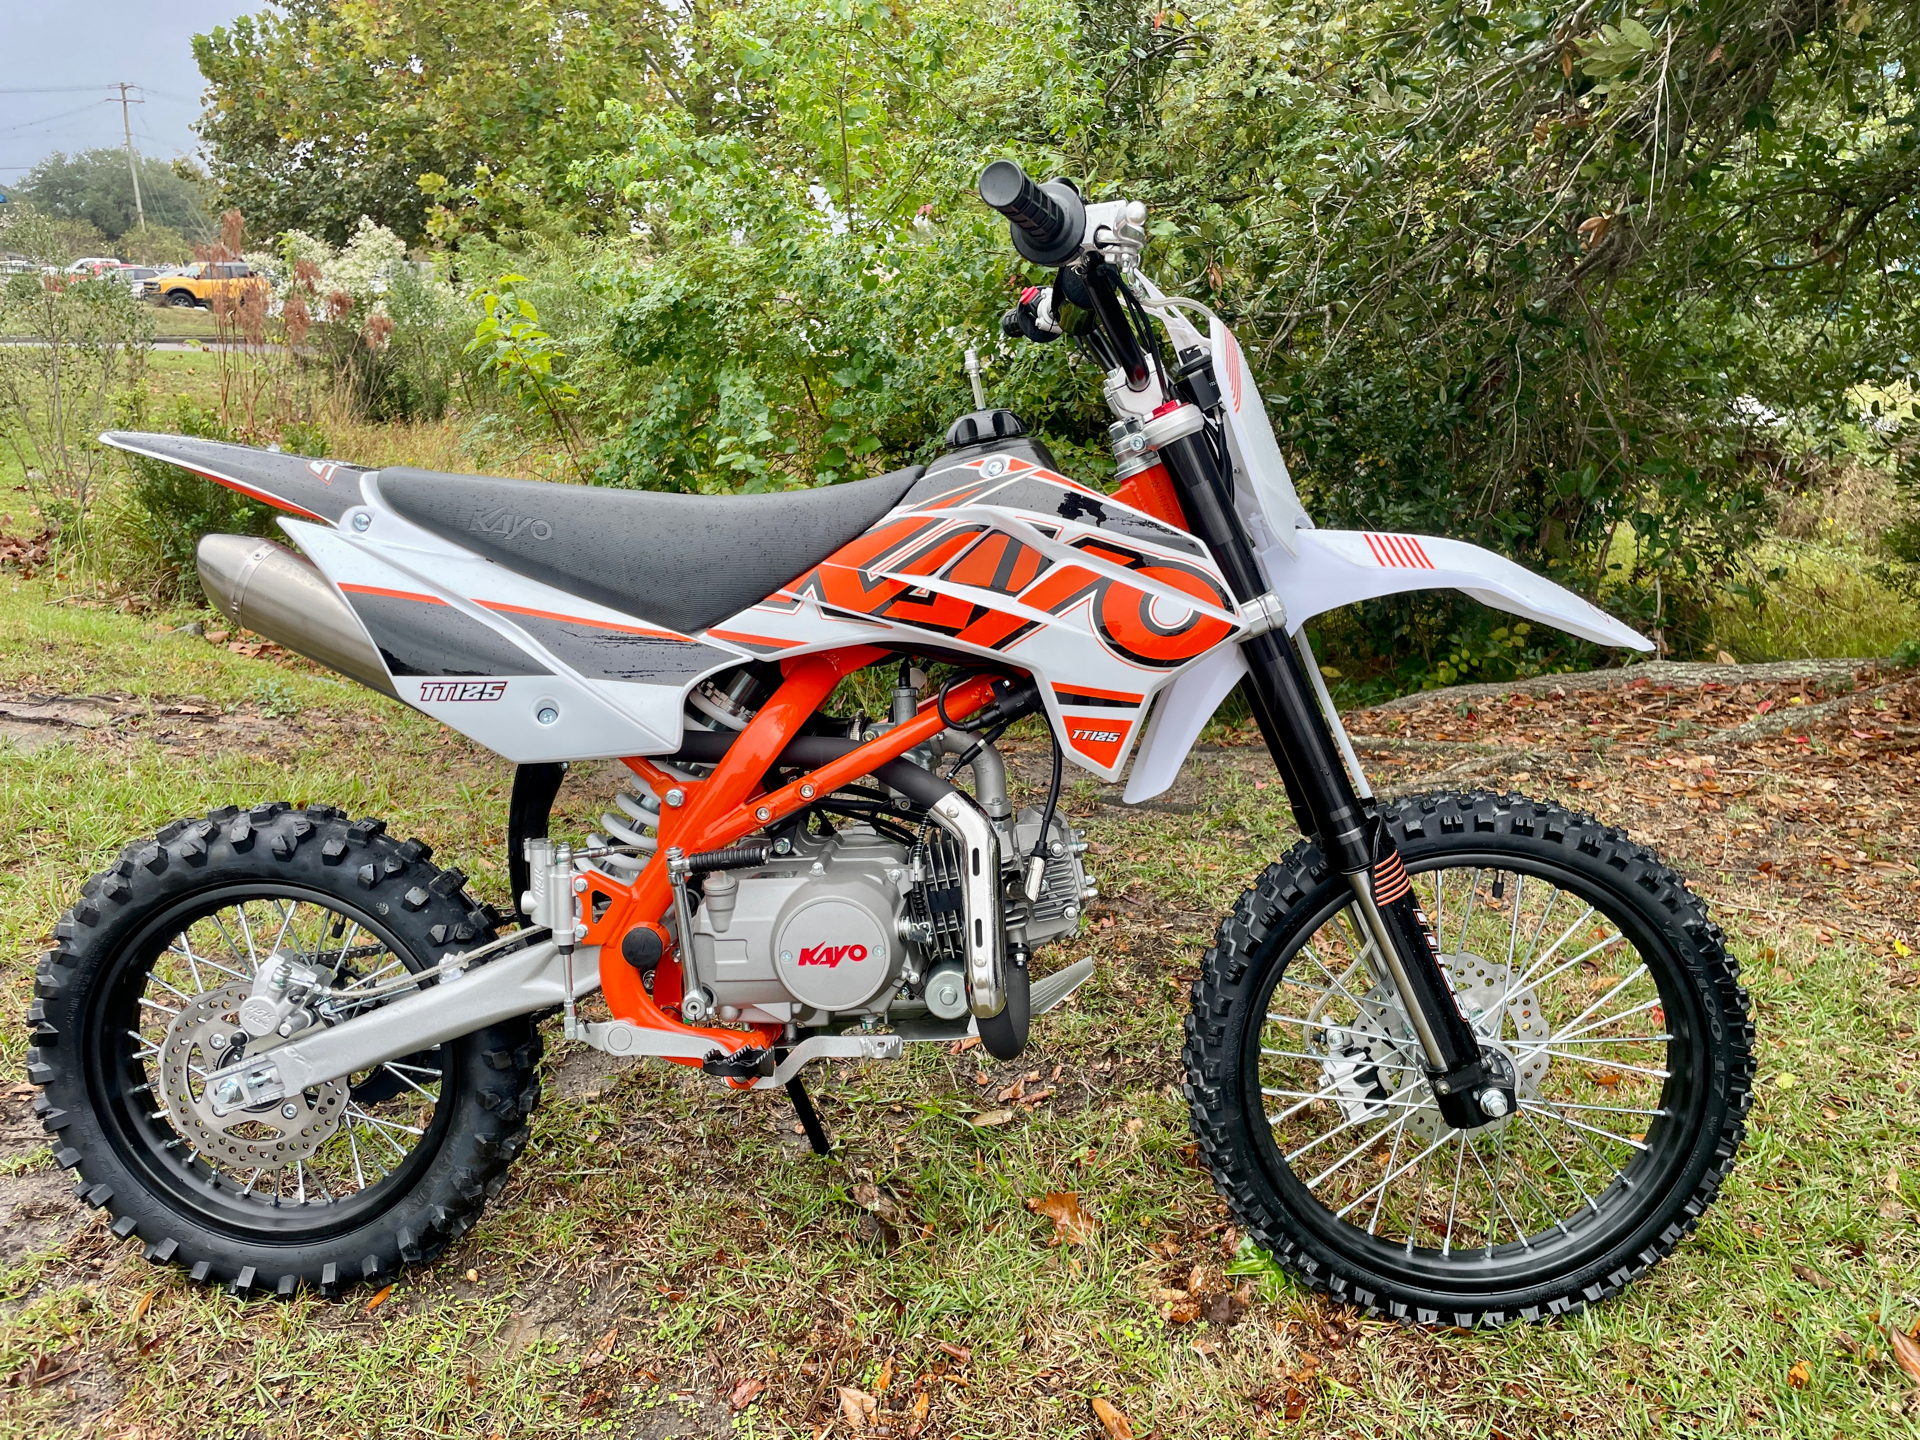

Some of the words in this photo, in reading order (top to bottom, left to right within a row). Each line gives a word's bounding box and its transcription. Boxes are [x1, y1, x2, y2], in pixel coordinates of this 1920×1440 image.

[468, 504, 553, 540] KAYO
[420, 681, 508, 702] TT125
[1071, 729, 1122, 743] TT125
[798, 941, 868, 969] KAYO
